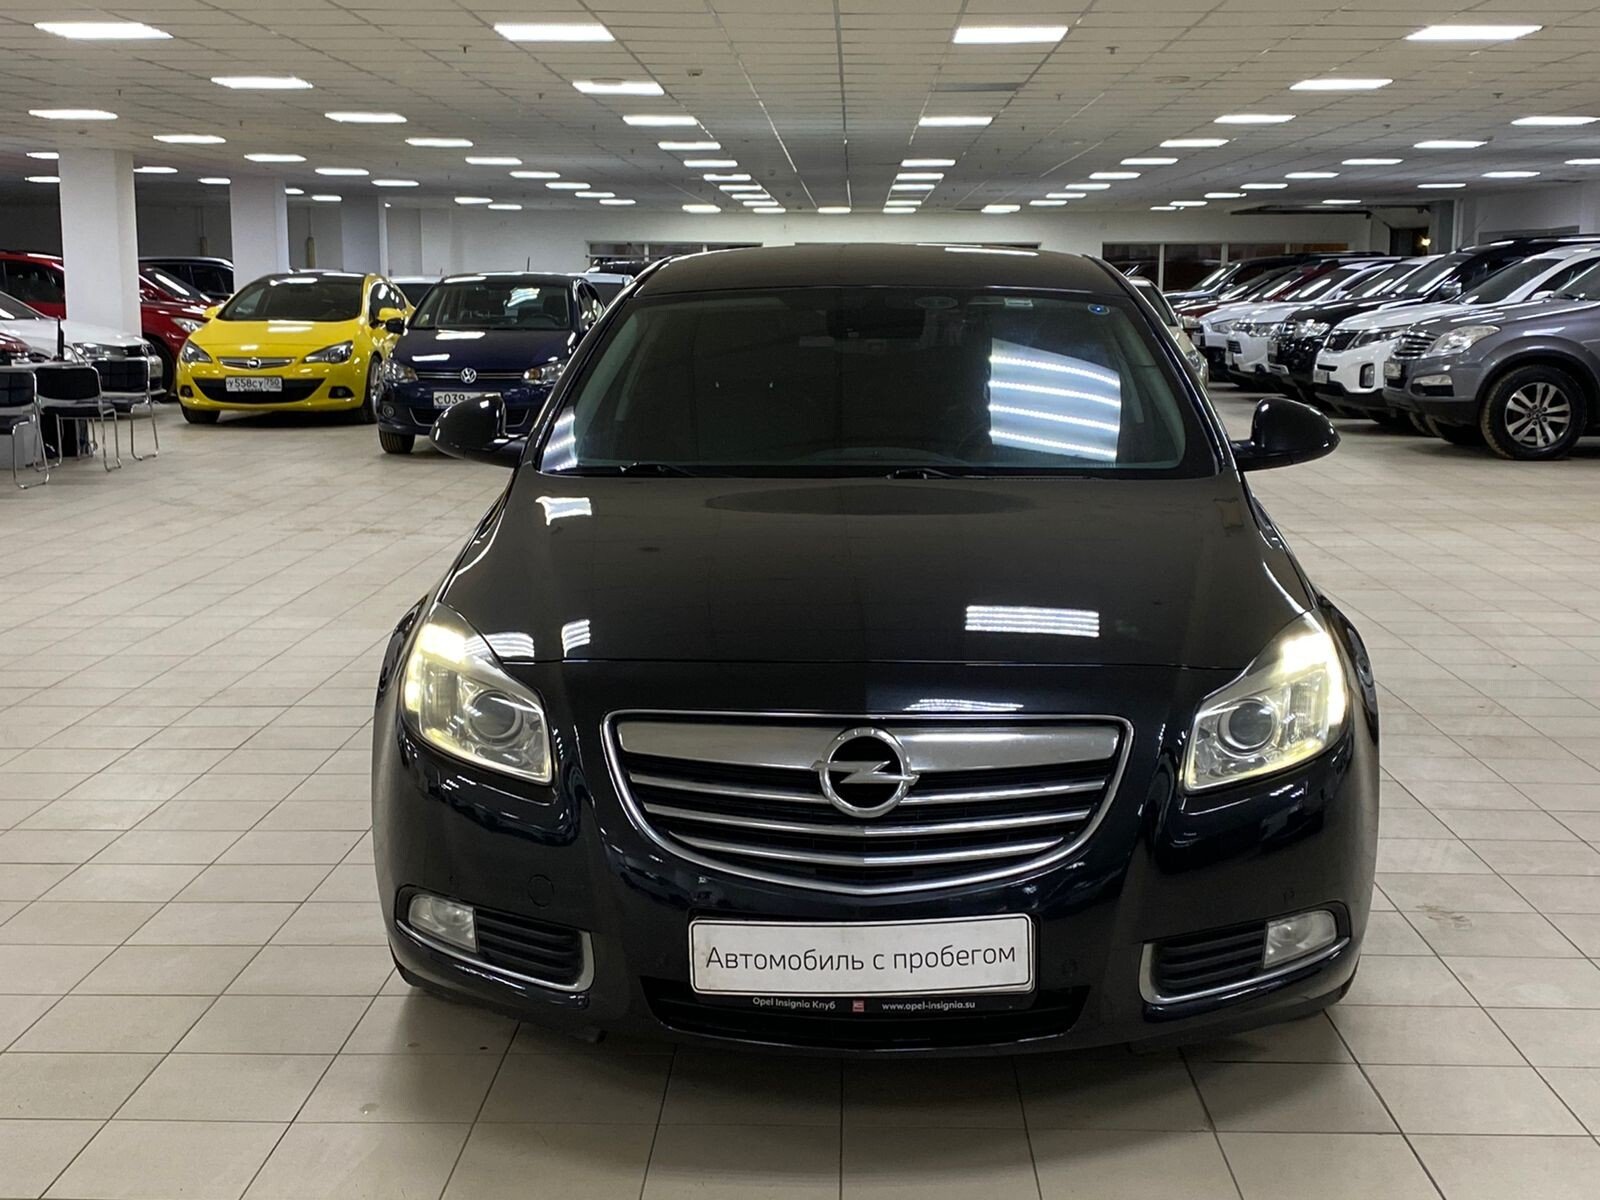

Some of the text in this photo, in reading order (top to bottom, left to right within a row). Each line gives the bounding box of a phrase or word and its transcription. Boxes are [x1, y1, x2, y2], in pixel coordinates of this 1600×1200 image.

[705, 944, 1015, 973] Автомобиль с пробегом
[752, 997, 774, 1007] Opel
[775, 998, 811, 1009] Insignia
[881, 1000, 976, 1012] www.opel-insignia.su
